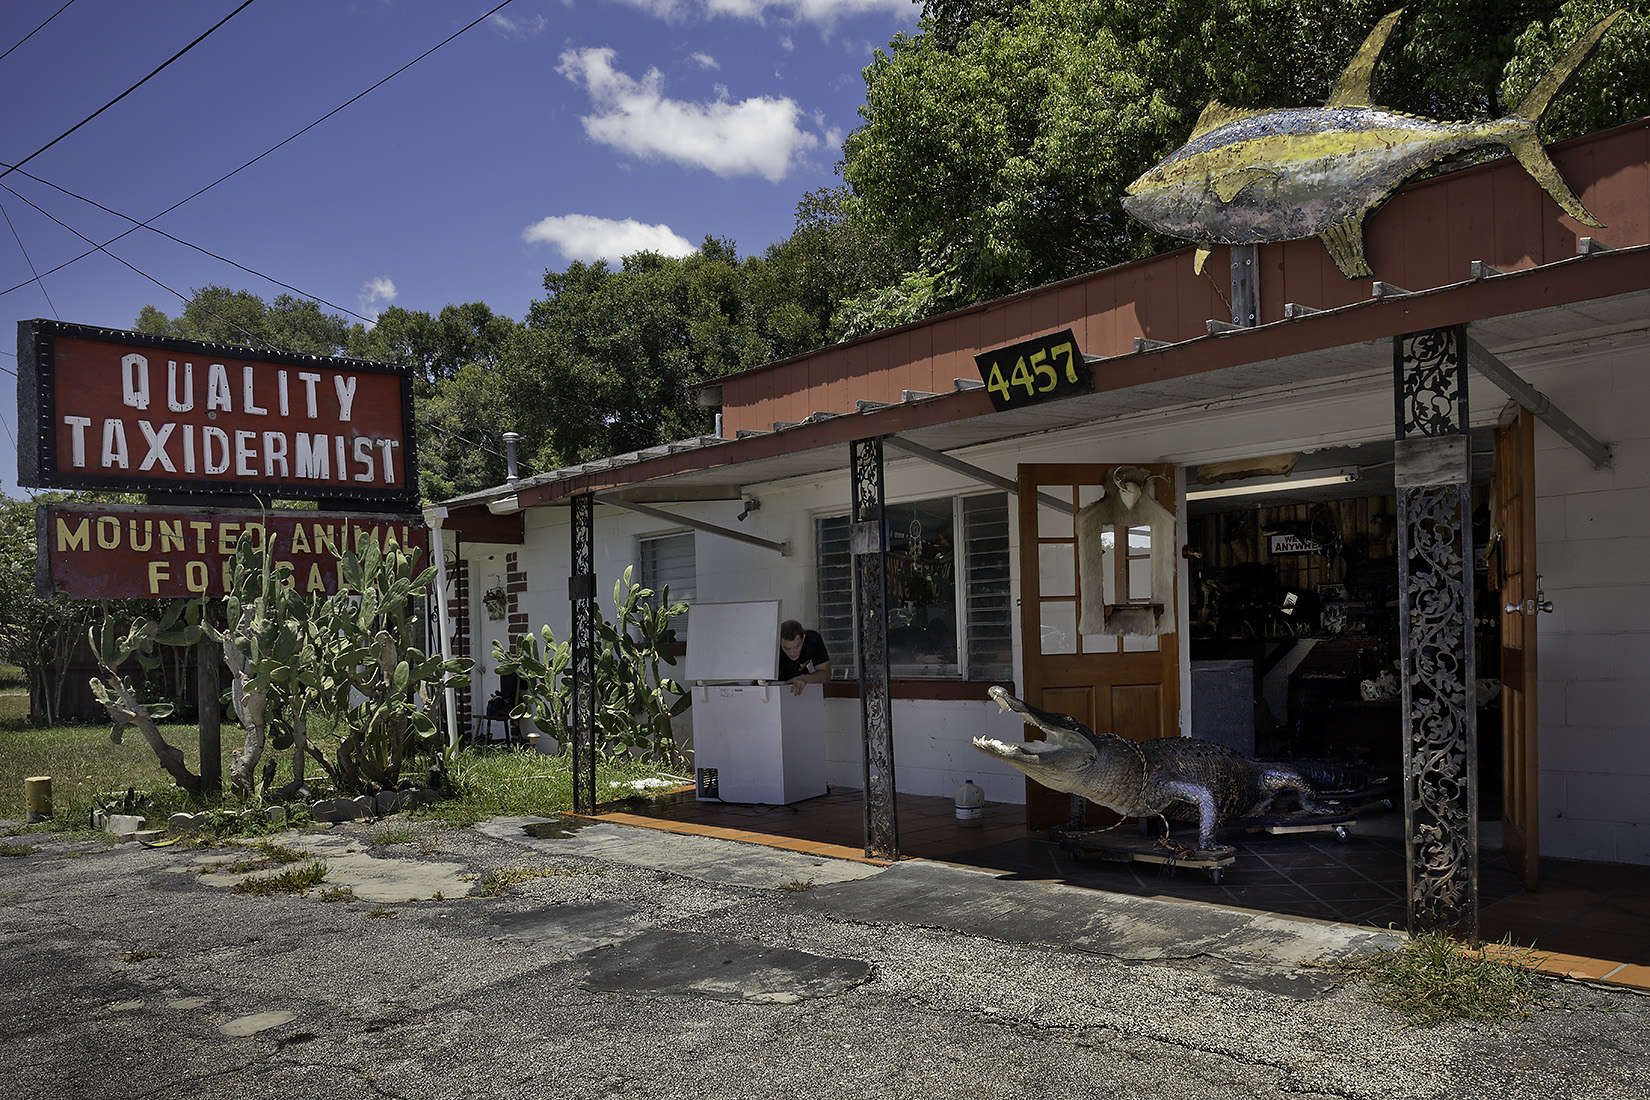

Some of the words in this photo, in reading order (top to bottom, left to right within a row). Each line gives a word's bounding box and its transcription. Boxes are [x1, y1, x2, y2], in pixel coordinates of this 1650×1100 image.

[121, 353, 357, 422] QUALITY
[987, 341, 1079, 402] 4457
[64, 415, 399, 484] TAXIDERMIST
[57, 516, 265, 555] MOUNTED
